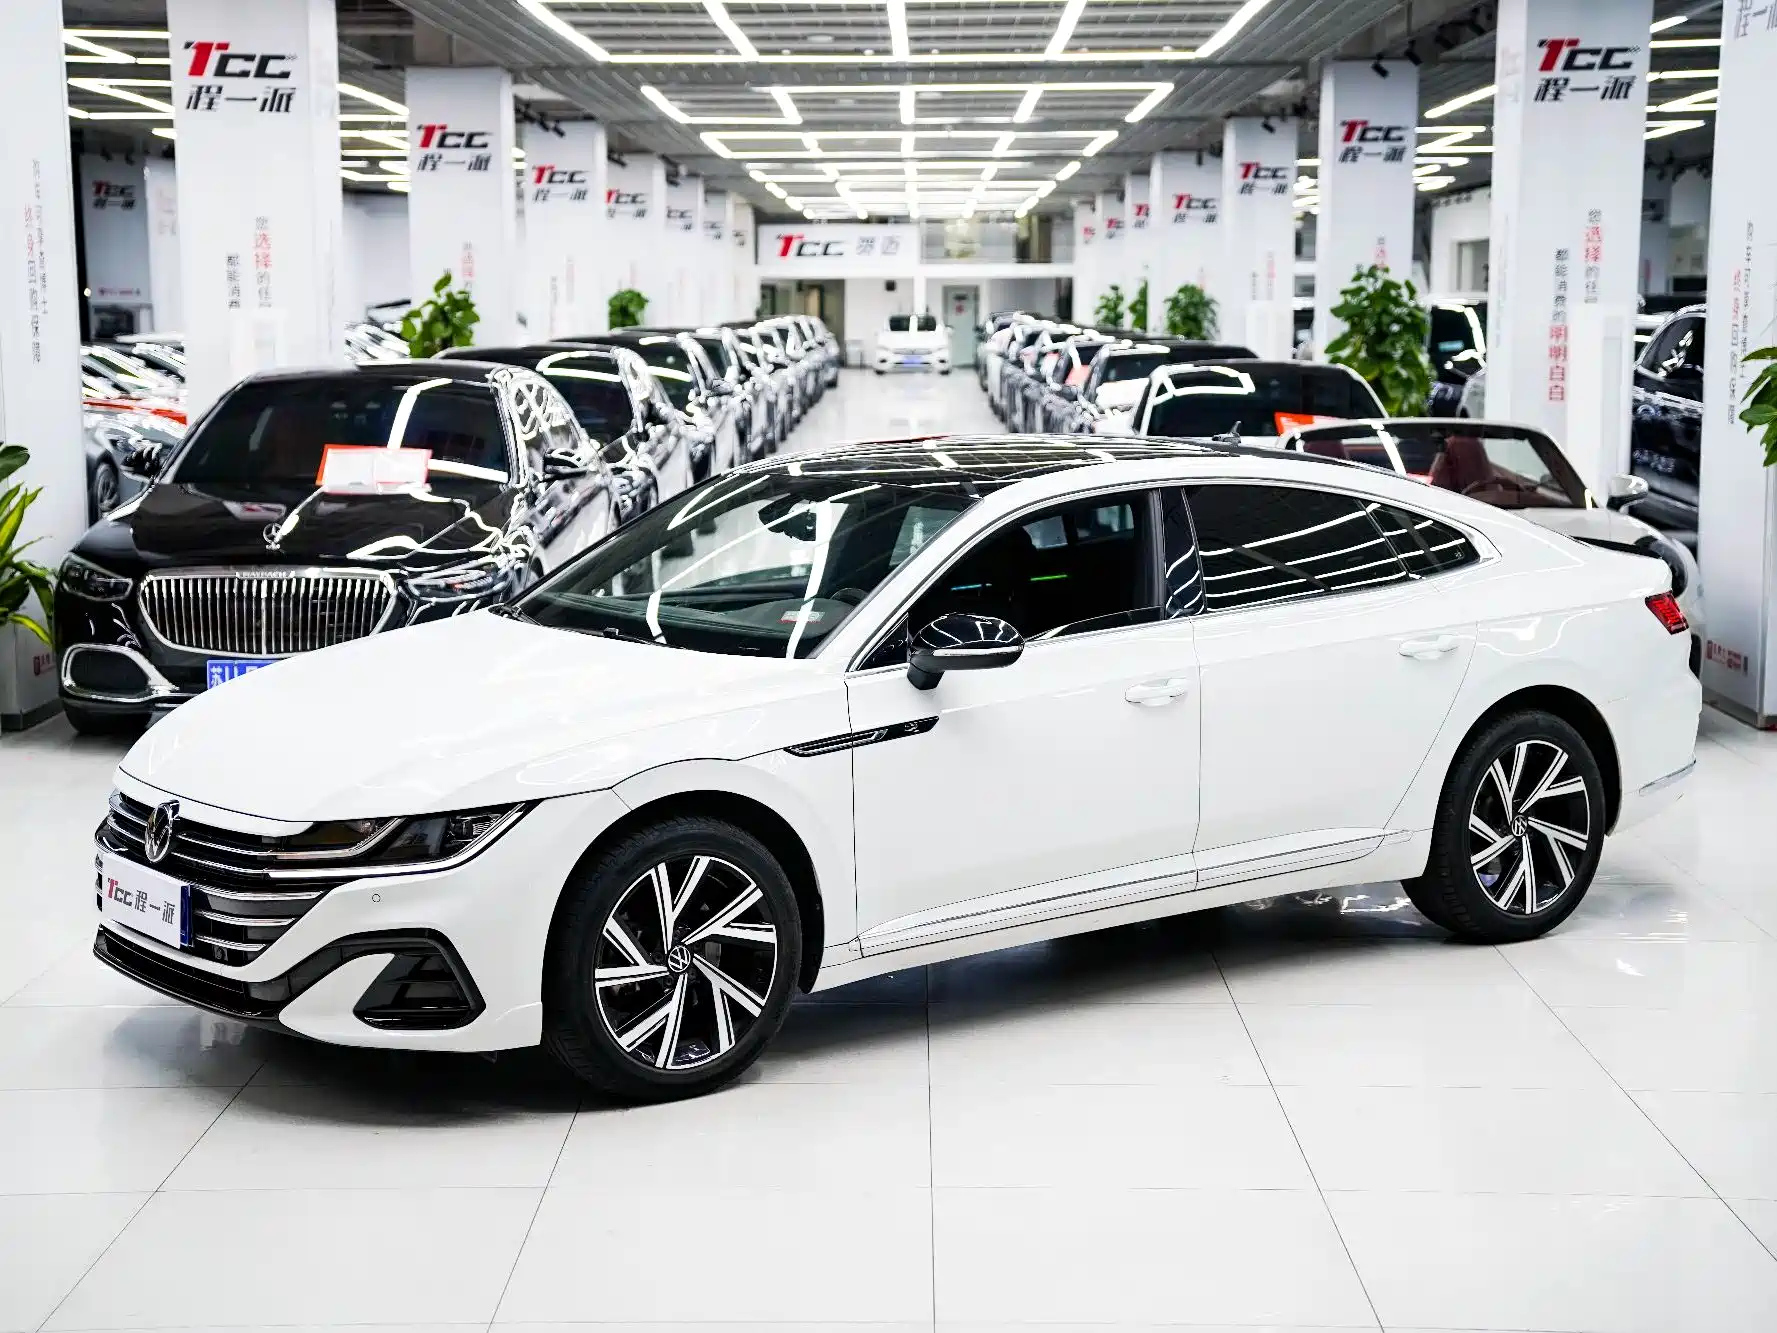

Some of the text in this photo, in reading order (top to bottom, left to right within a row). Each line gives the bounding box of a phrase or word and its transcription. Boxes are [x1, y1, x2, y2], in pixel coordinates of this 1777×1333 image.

[184, 40, 294, 78] TCC
[1537, 37, 1637, 72] TCC
[186, 85, 297, 113] 程一派
[1534, 76, 1637, 101] 程一派
[417, 124, 491, 148] TCC
[1340, 119, 1406, 143] TCC
[531, 165, 587, 184] TCC
[1238, 161, 1288, 180] TCC
[777, 233, 845, 257] TCC
[107, 877, 176, 925] TCC 程一派
